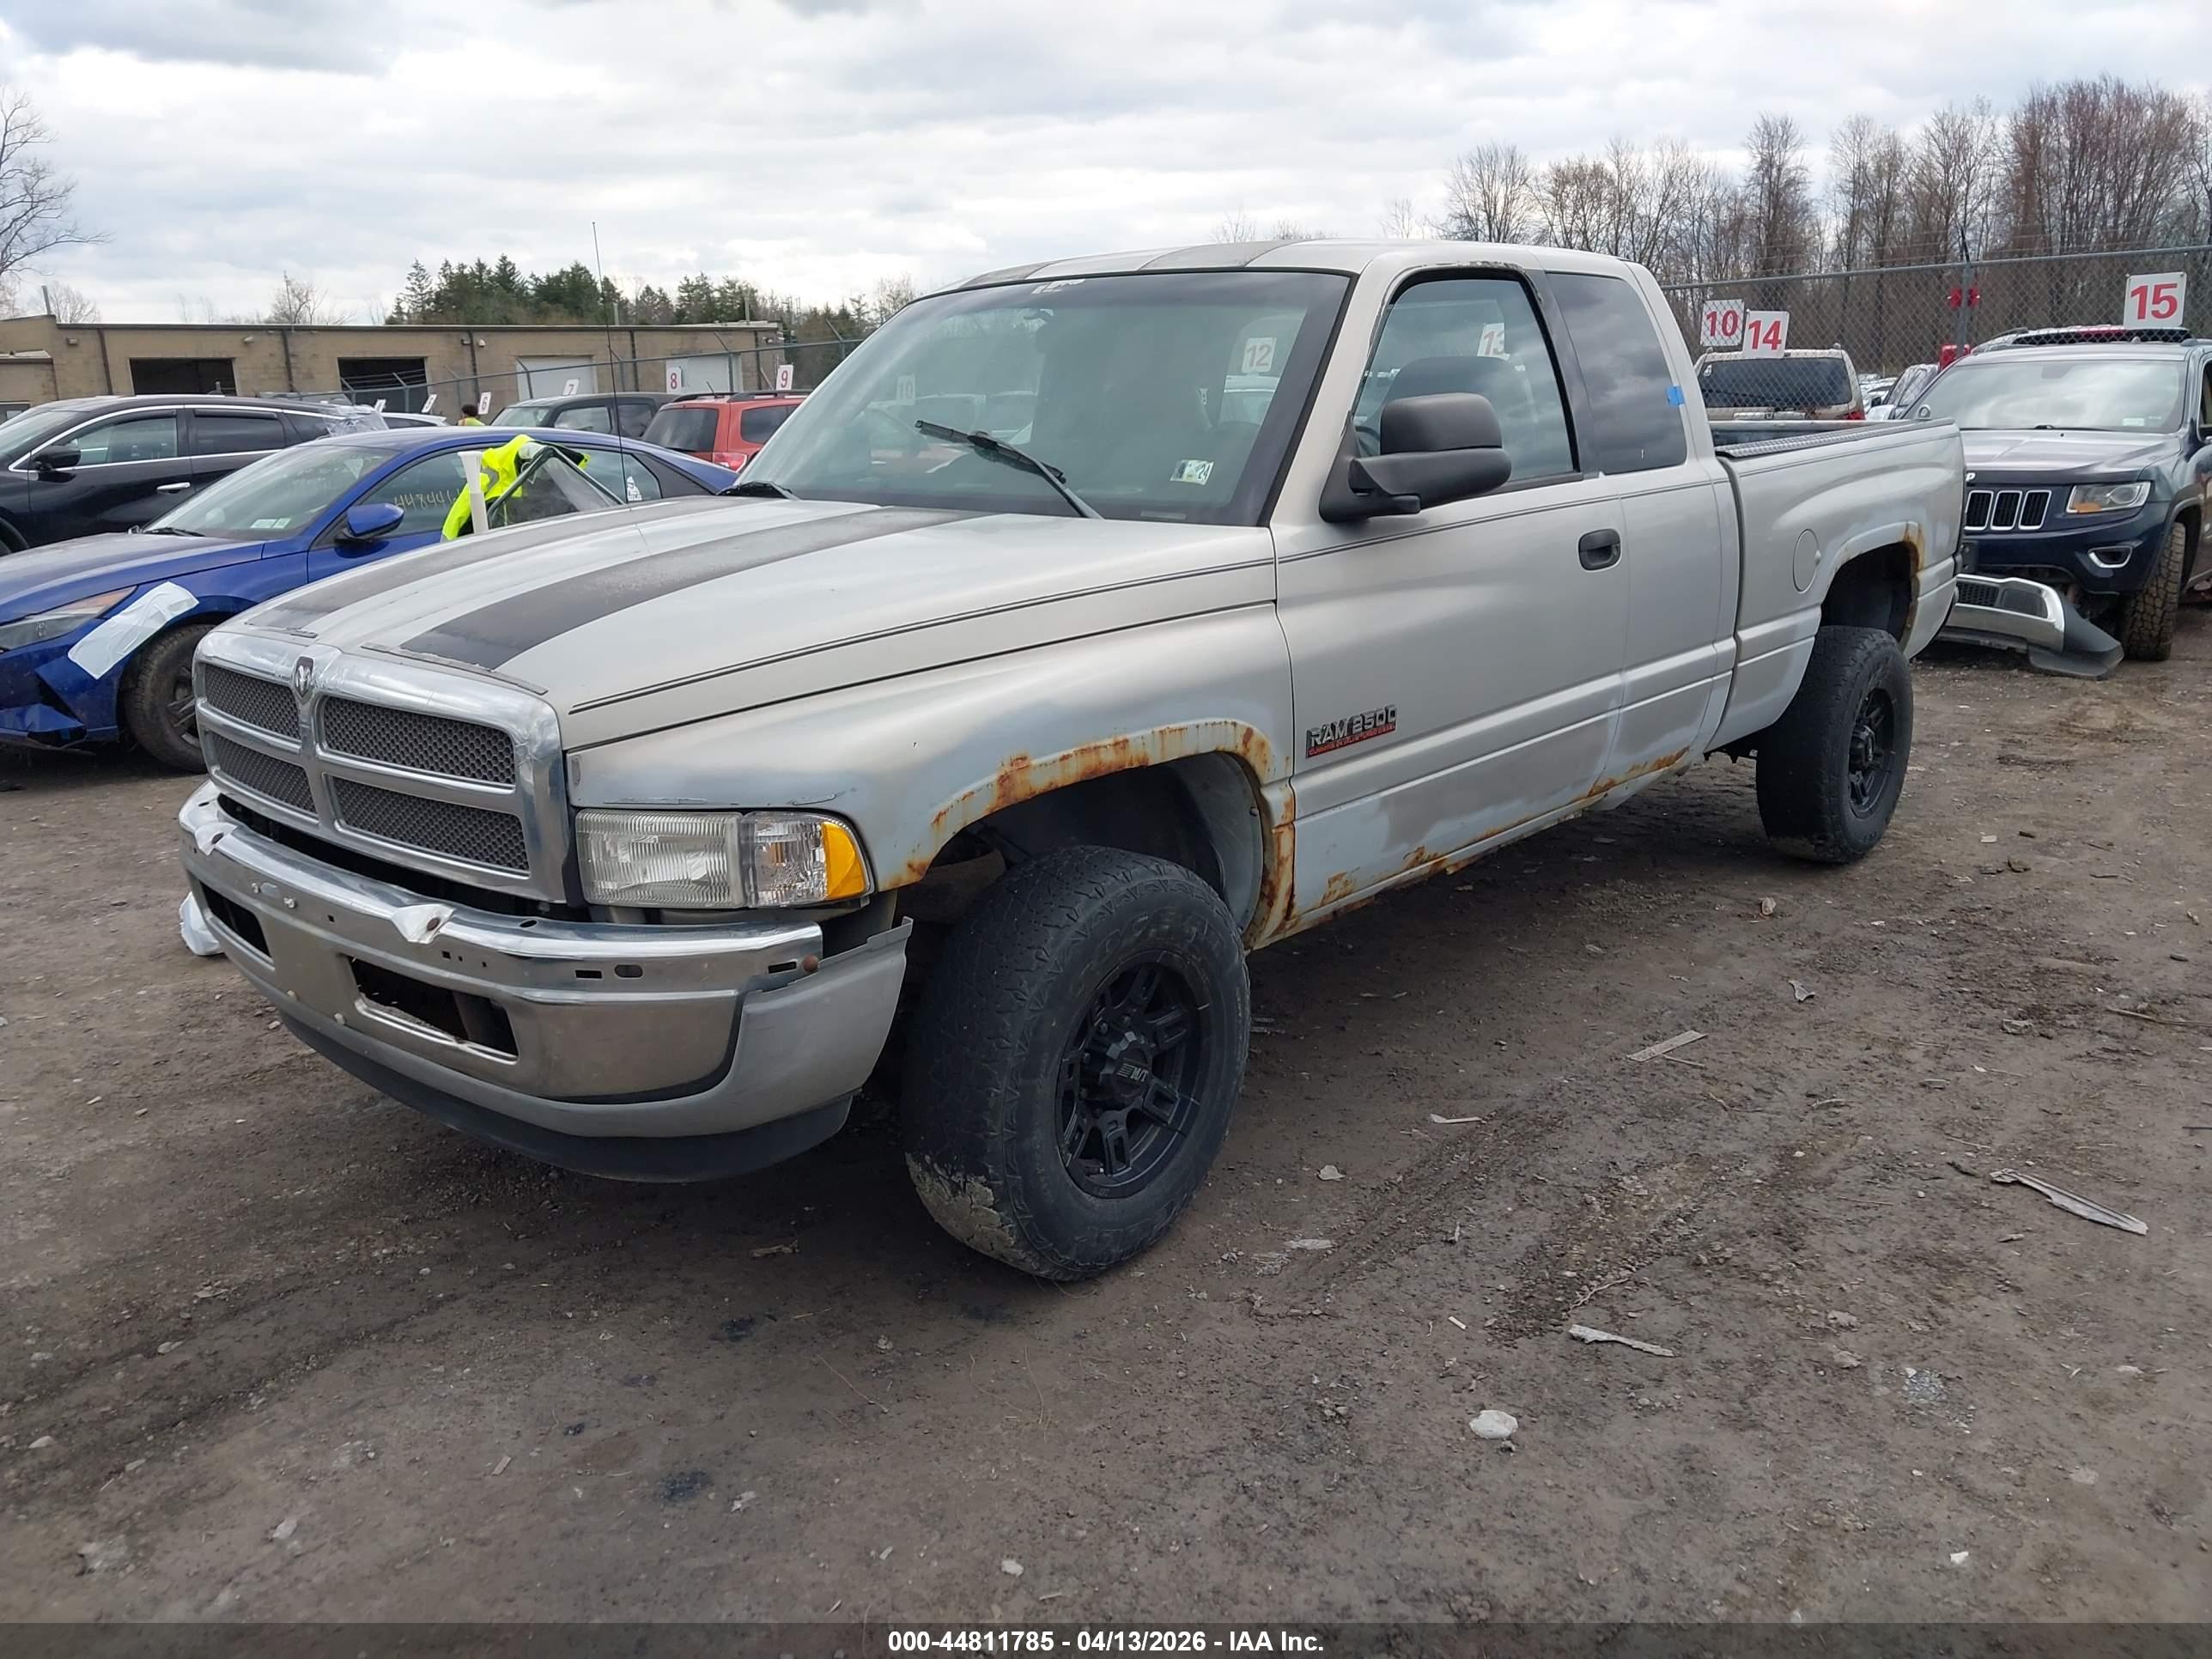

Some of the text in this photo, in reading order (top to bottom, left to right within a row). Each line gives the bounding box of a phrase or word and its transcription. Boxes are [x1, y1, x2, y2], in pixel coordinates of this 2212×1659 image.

[2130, 283, 2179, 320] 15
[1706, 309, 1739, 337] 10
[1748, 319, 1783, 350] 14
[1246, 343, 1272, 367] 12
[670, 372, 678, 390] 8
[780, 370, 789, 387] 9
[481, 396, 489, 410] 6
[1306, 719, 1349, 750] RAM
